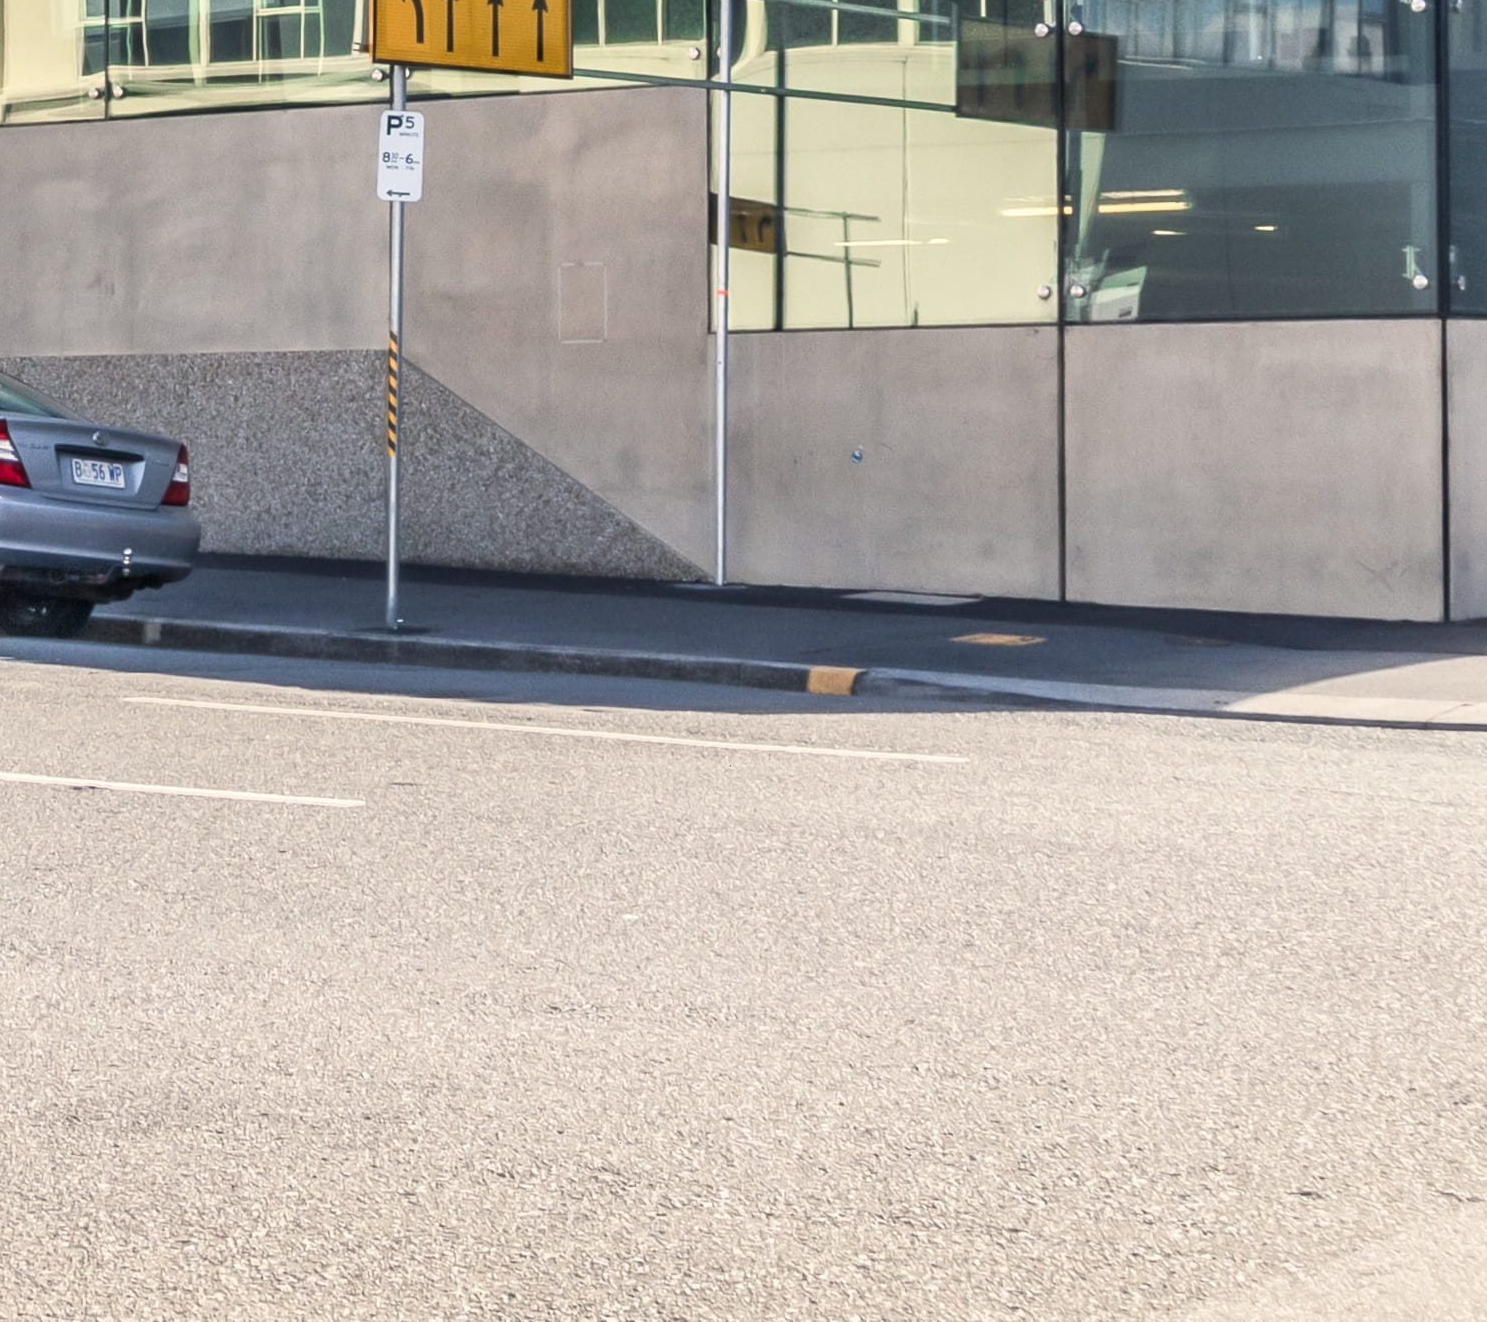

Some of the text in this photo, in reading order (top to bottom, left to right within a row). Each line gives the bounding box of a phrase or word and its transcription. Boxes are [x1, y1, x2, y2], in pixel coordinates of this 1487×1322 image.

[382, 151, 391, 163] 8
[74, 459, 122, 482] B 56 WP
